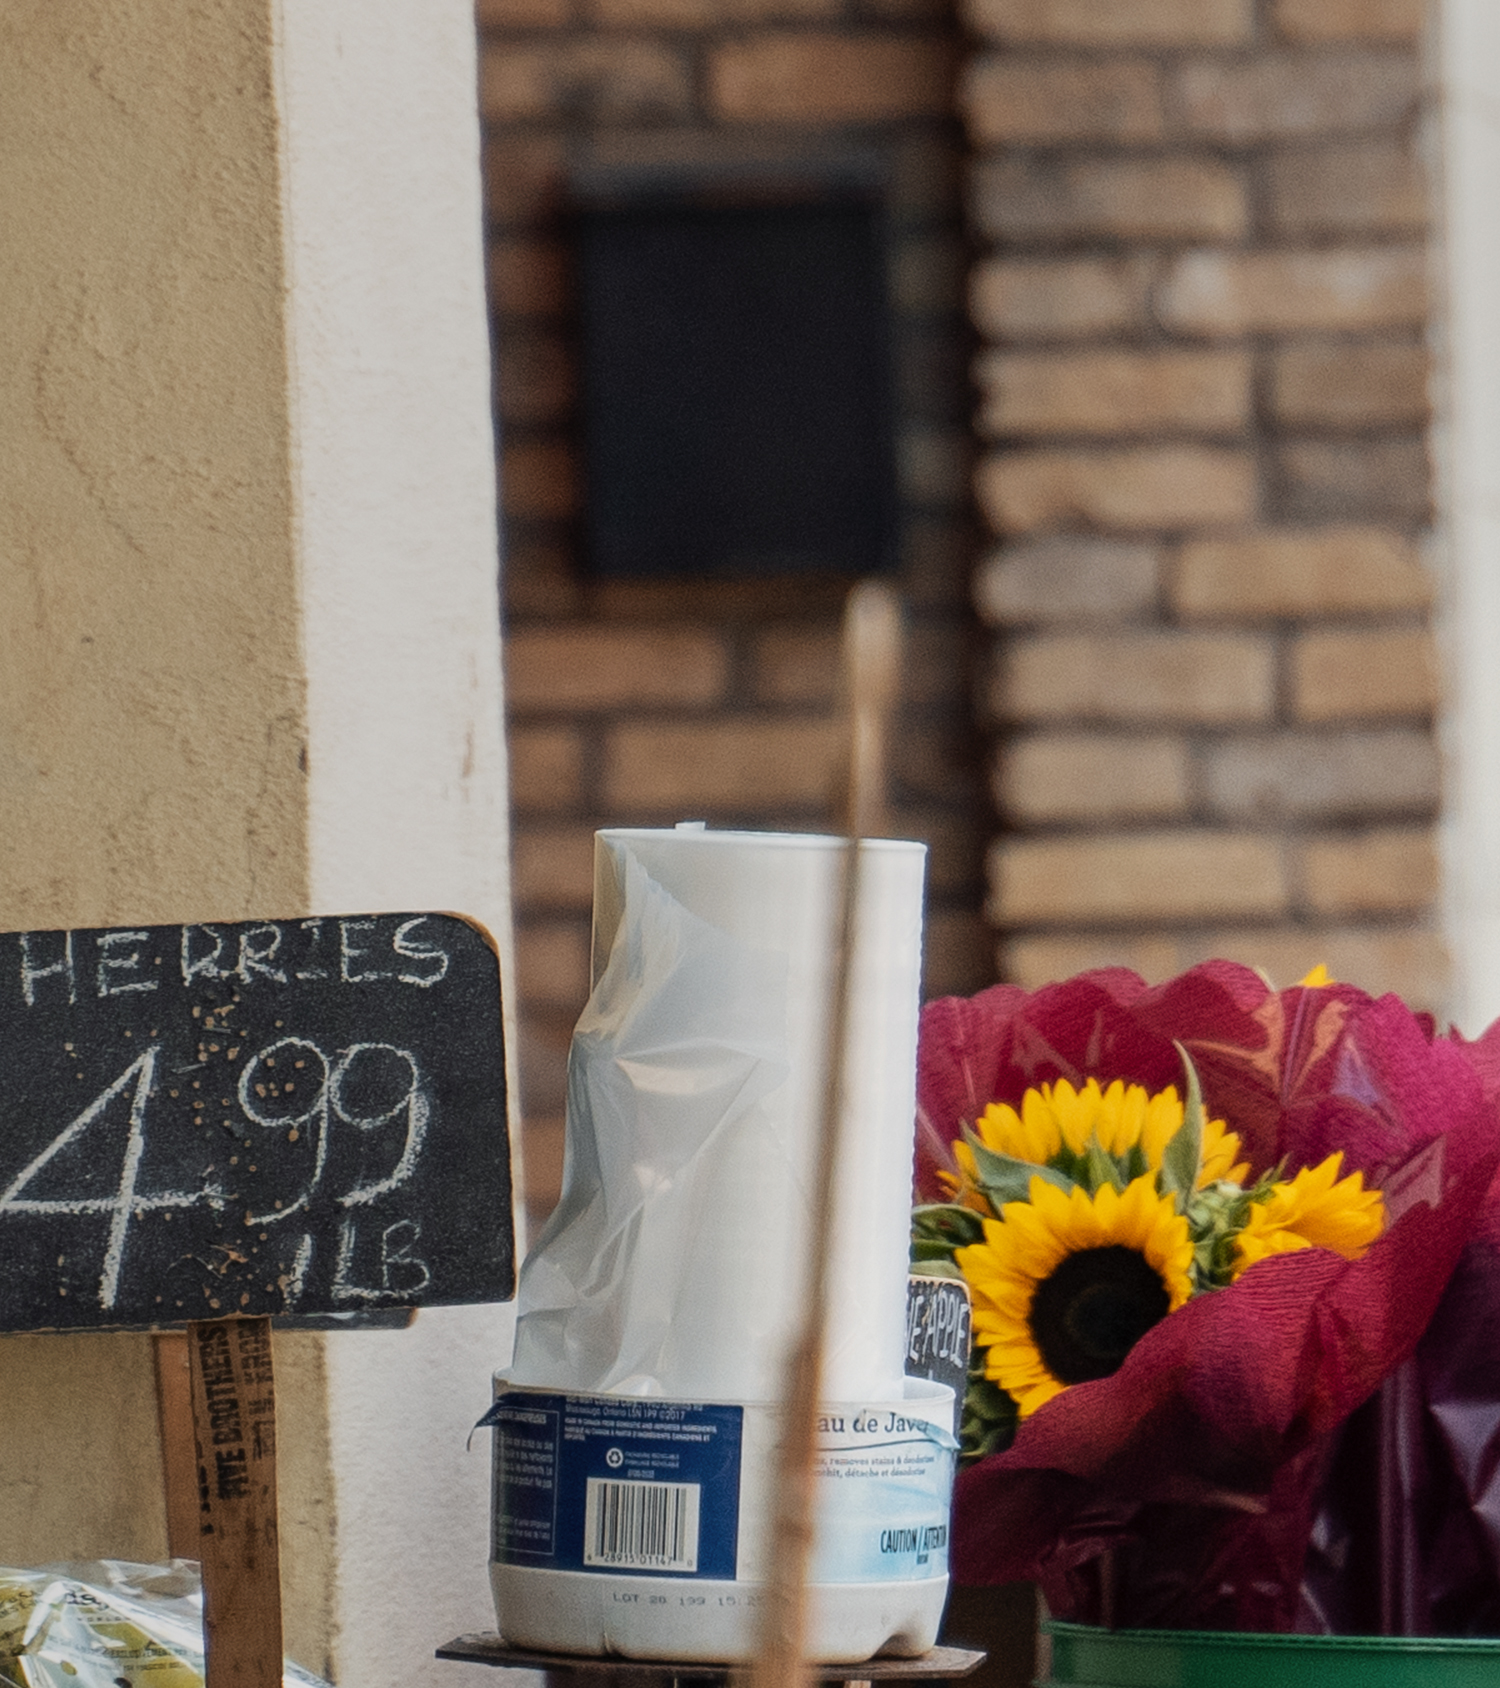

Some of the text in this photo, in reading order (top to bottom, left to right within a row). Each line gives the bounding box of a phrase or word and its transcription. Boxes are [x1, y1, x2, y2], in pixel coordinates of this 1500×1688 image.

[816, 1414, 845, 1434] au
[853, 1411, 879, 1434] de
[612, 1592, 640, 1604] LOT
